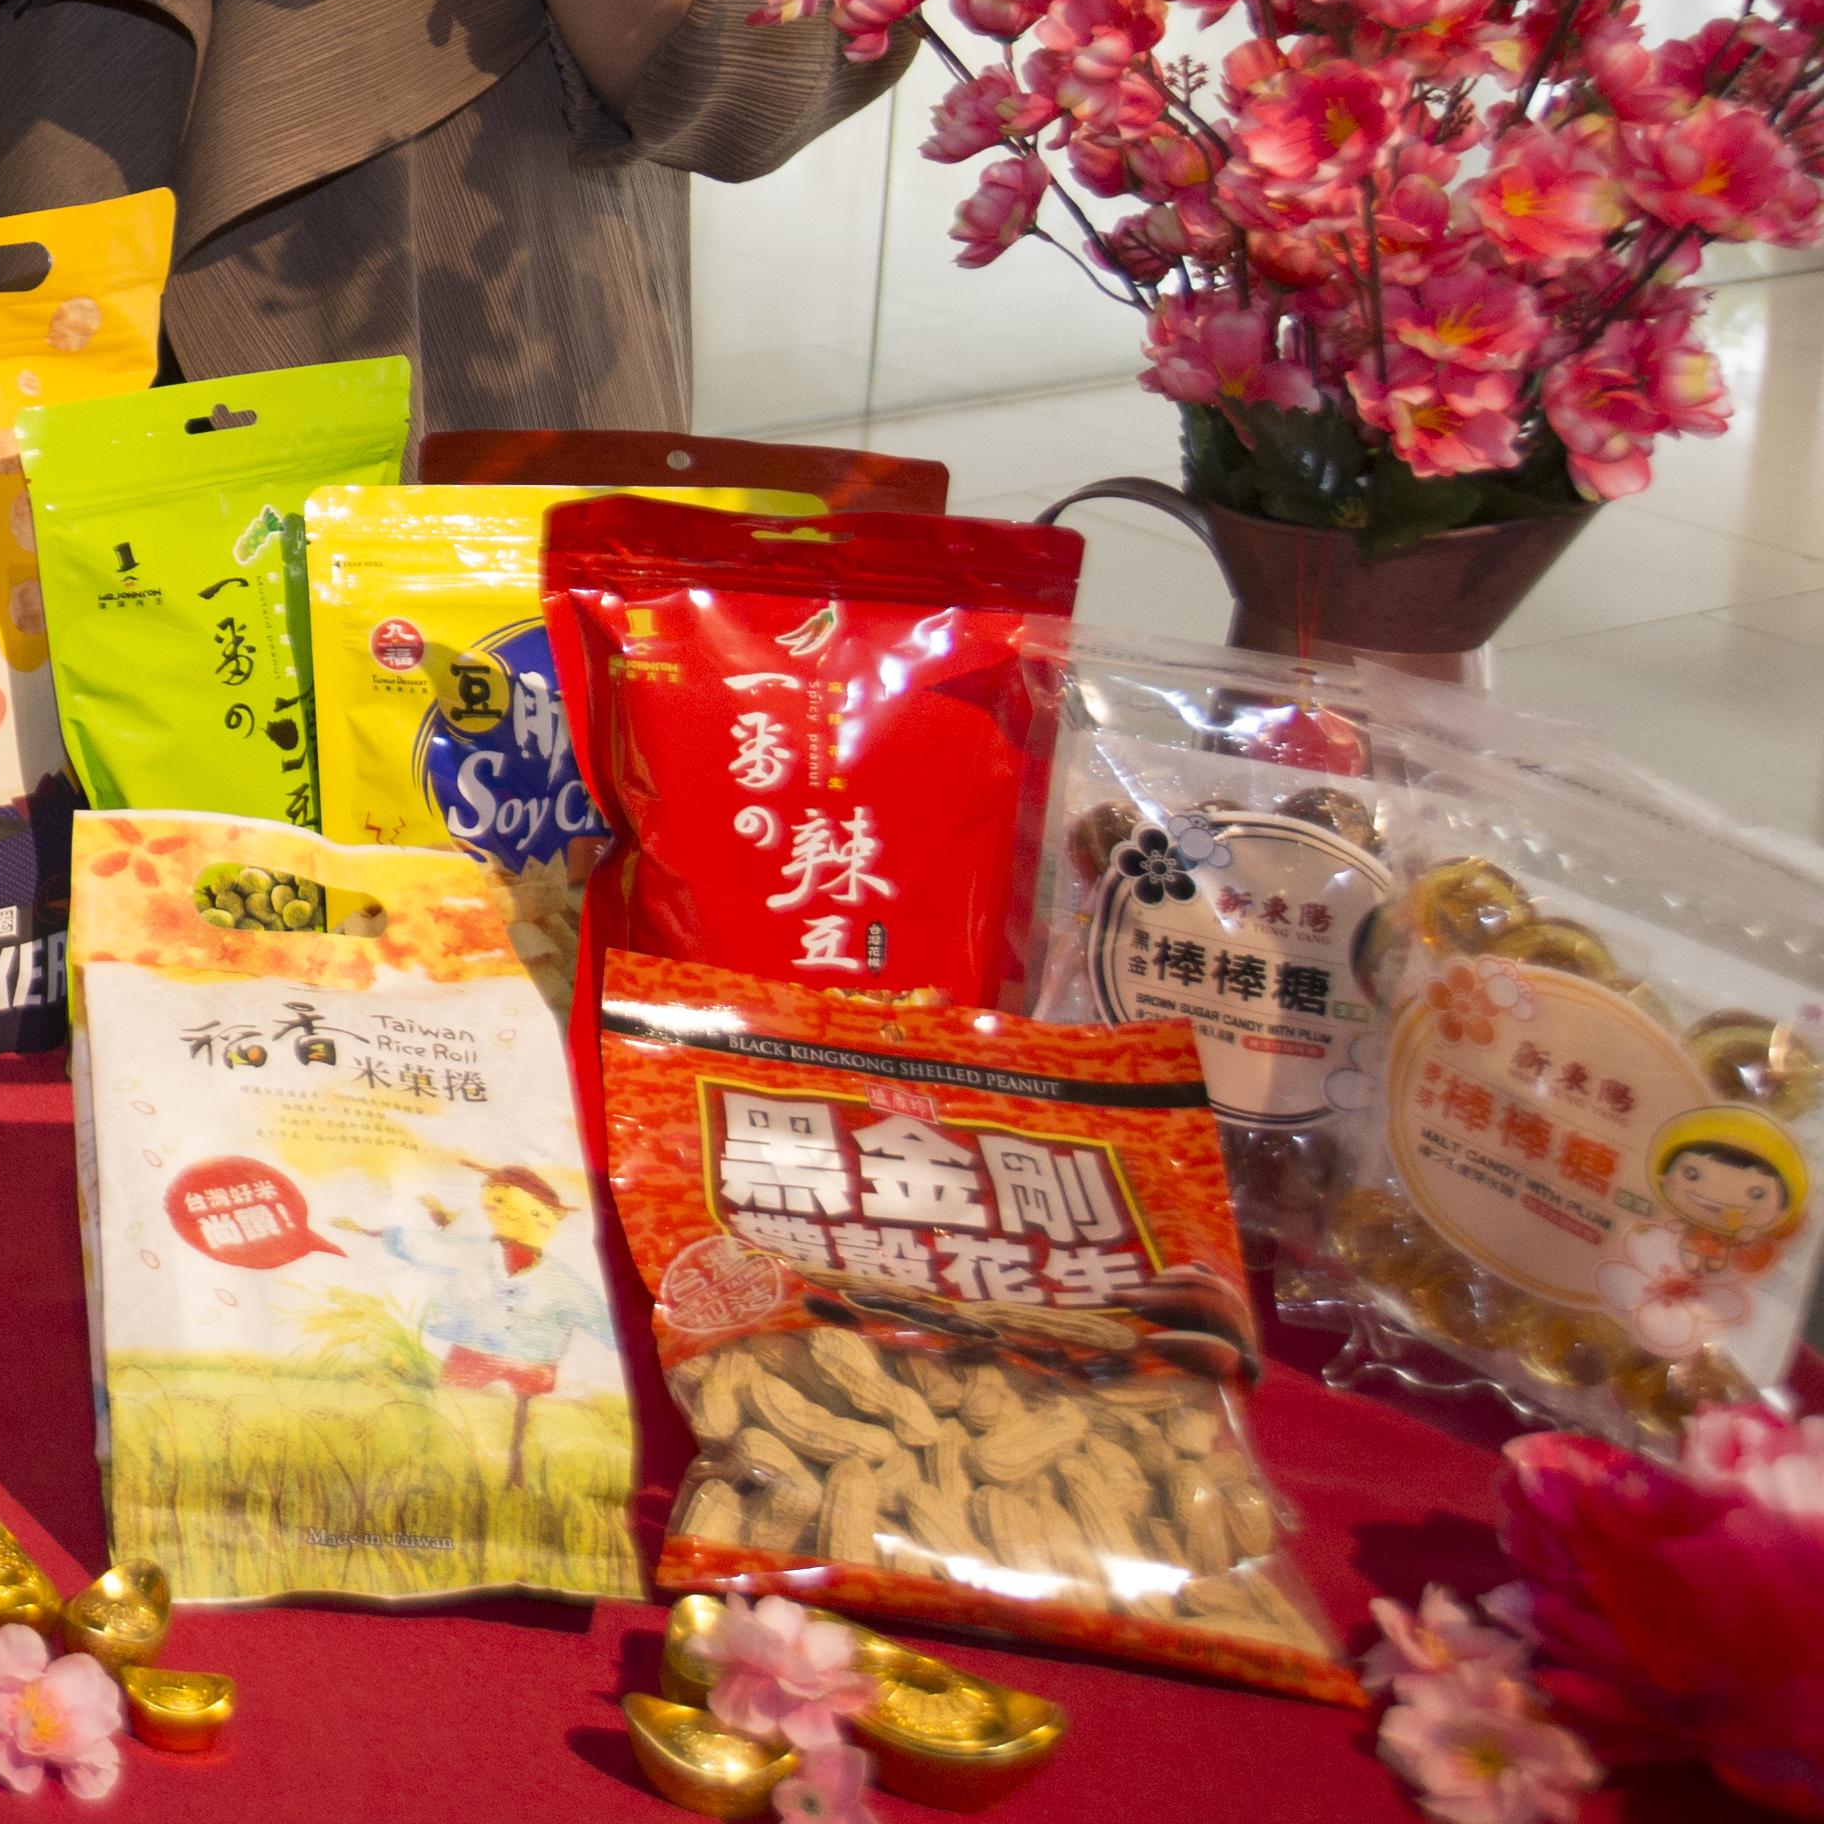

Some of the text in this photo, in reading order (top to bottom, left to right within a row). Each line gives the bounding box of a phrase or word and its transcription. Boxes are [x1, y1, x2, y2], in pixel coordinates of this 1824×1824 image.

[198, 577, 255, 739] 一番の
[268, 635, 281, 681] peanut
[723, 672, 800, 848] 一番の
[806, 679, 821, 788] Spicy peanut
[448, 751, 549, 850] Soy
[765, 806, 893, 970] 辣豆
[1216, 885, 1332, 933] 新東陽
[1128, 928, 1150, 977] 黑金
[1296, 932, 1331, 945] YANG
[1153, 935, 1330, 1017] 棒棒糖
[179, 1001, 370, 1069] 稻香
[371, 1014, 474, 1042] Taiwan
[1136, 993, 1332, 1044] BROWN SUGAR CANDY WITH PLUM
[378, 1034, 477, 1064] Rice Roll
[727, 1034, 1061, 1098] BLACK KINGKONG SHELLED PEANUT
[352, 1056, 488, 1103] 米菓捲
[183, 1179, 279, 1213] 台灣好米
[720, 1091, 1127, 1244] 黑金剛
[1421, 1127, 1461, 1152] MALT
[1465, 1149, 1521, 1180] CANDY
[1526, 1178, 1561, 1204] WITH
[1566, 1200, 1612, 1231] PLUM
[308, 1526, 453, 1552] Made in Taiwan
